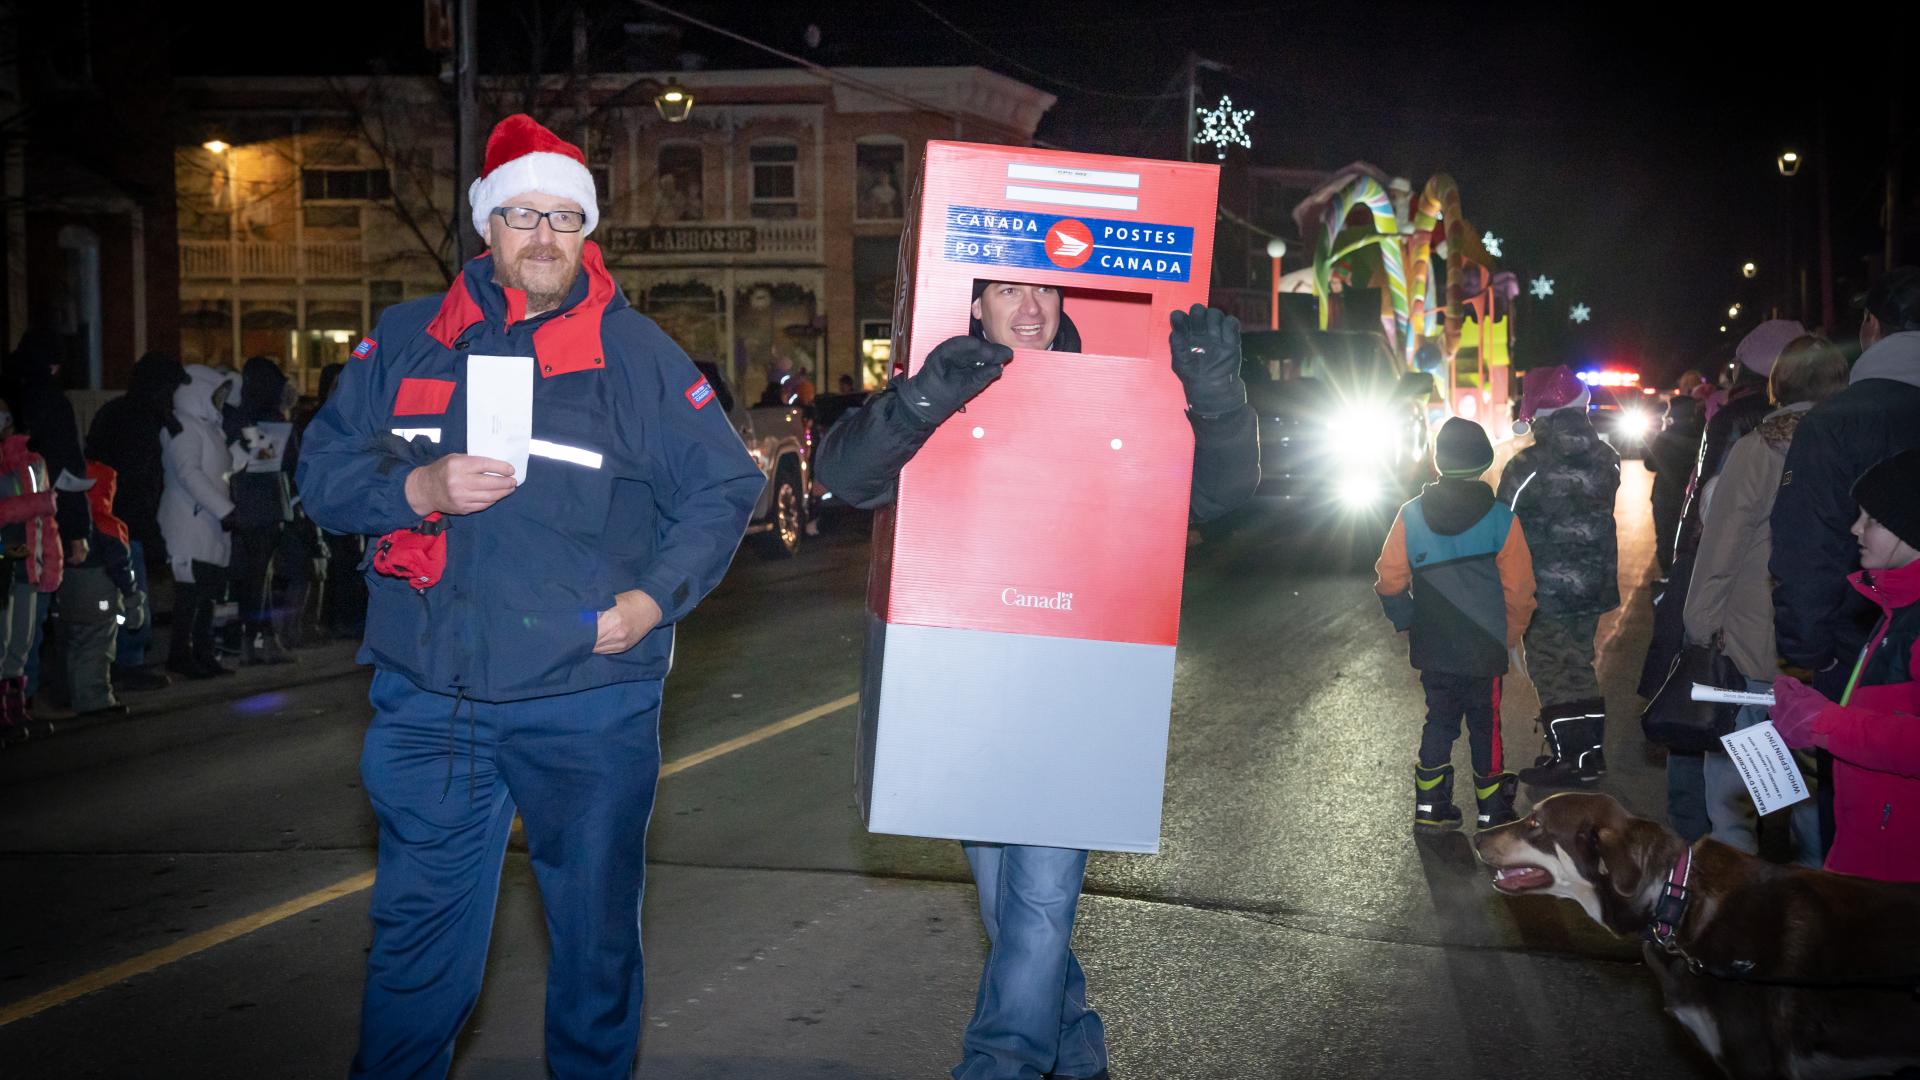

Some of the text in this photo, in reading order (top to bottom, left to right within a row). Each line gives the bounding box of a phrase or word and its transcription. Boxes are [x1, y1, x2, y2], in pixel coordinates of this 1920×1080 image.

[956, 212, 1176, 245] CANADA POSTES
[955, 242, 1182, 274] POST CANADA
[1001, 587, 1073, 611] Canada
[1763, 730, 1801, 794] WHOLEPRINTING
